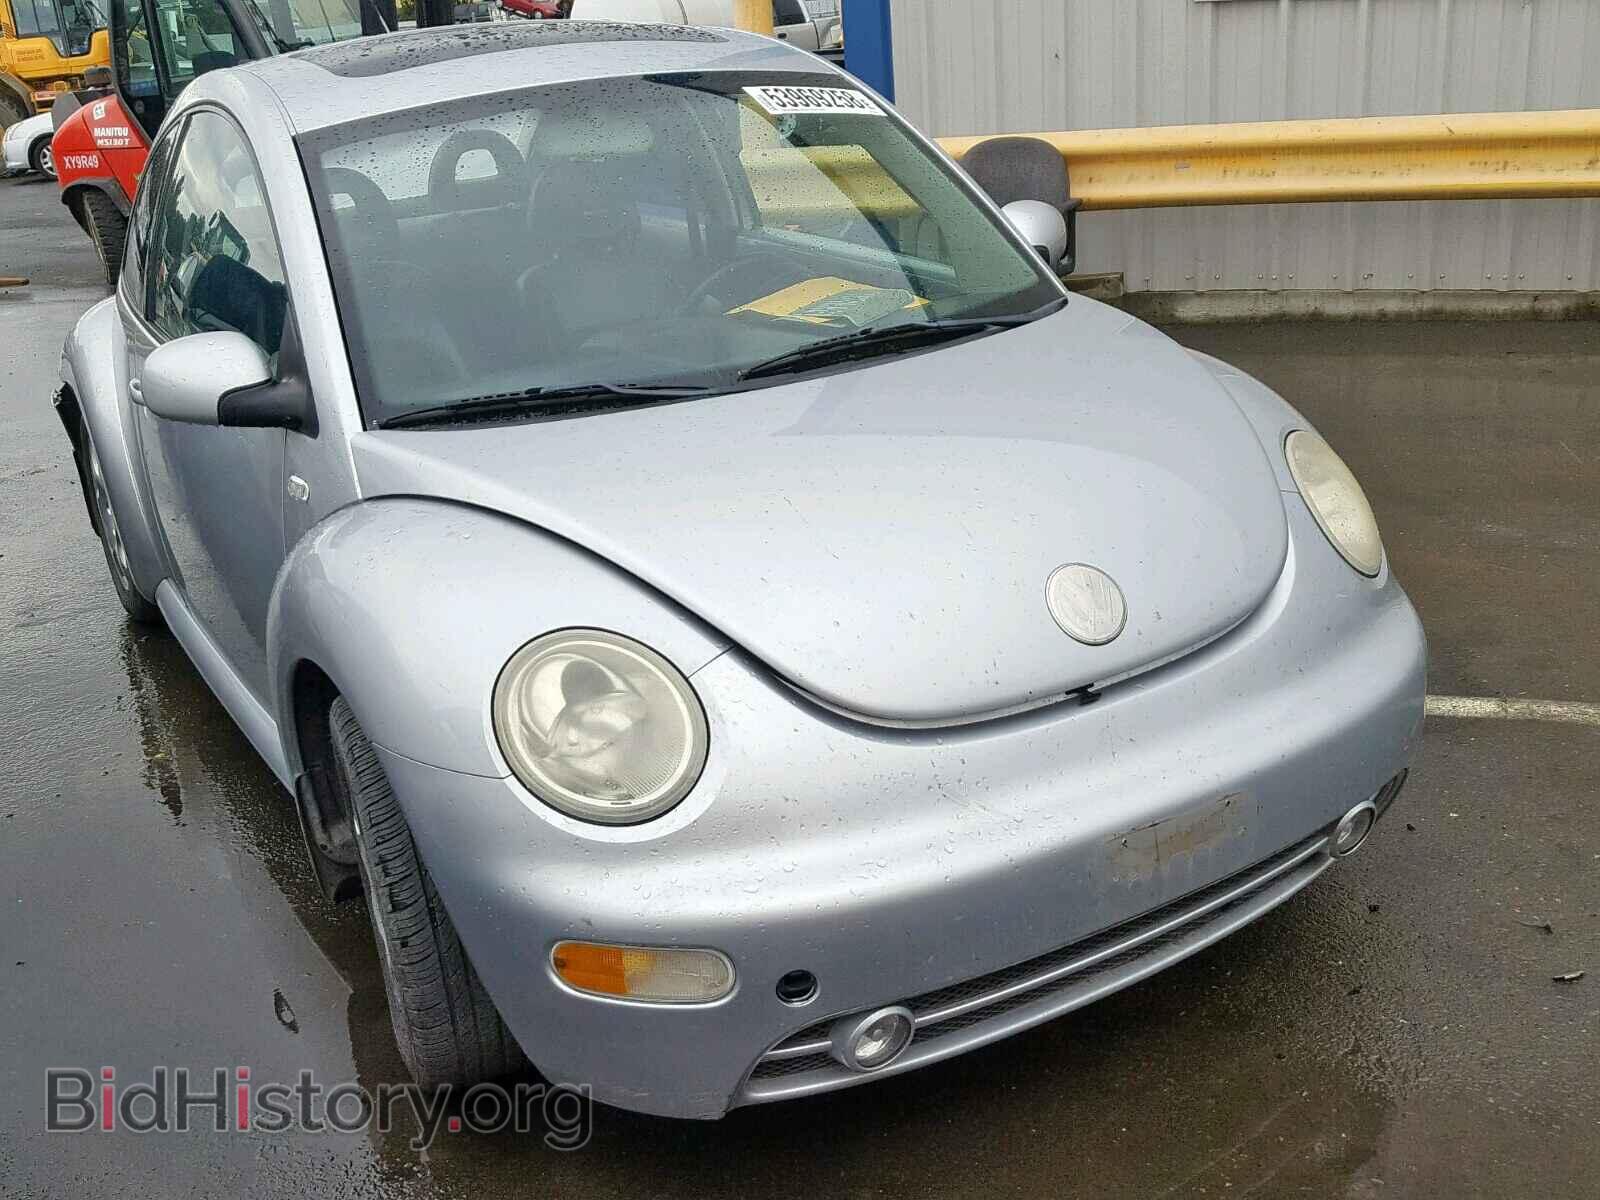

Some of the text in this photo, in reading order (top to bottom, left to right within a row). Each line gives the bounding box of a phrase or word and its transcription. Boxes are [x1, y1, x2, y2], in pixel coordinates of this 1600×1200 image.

[760, 88, 865, 109] 53969258
[94, 127, 128, 137] MANITOU
[64, 155, 99, 169] XY9R49
